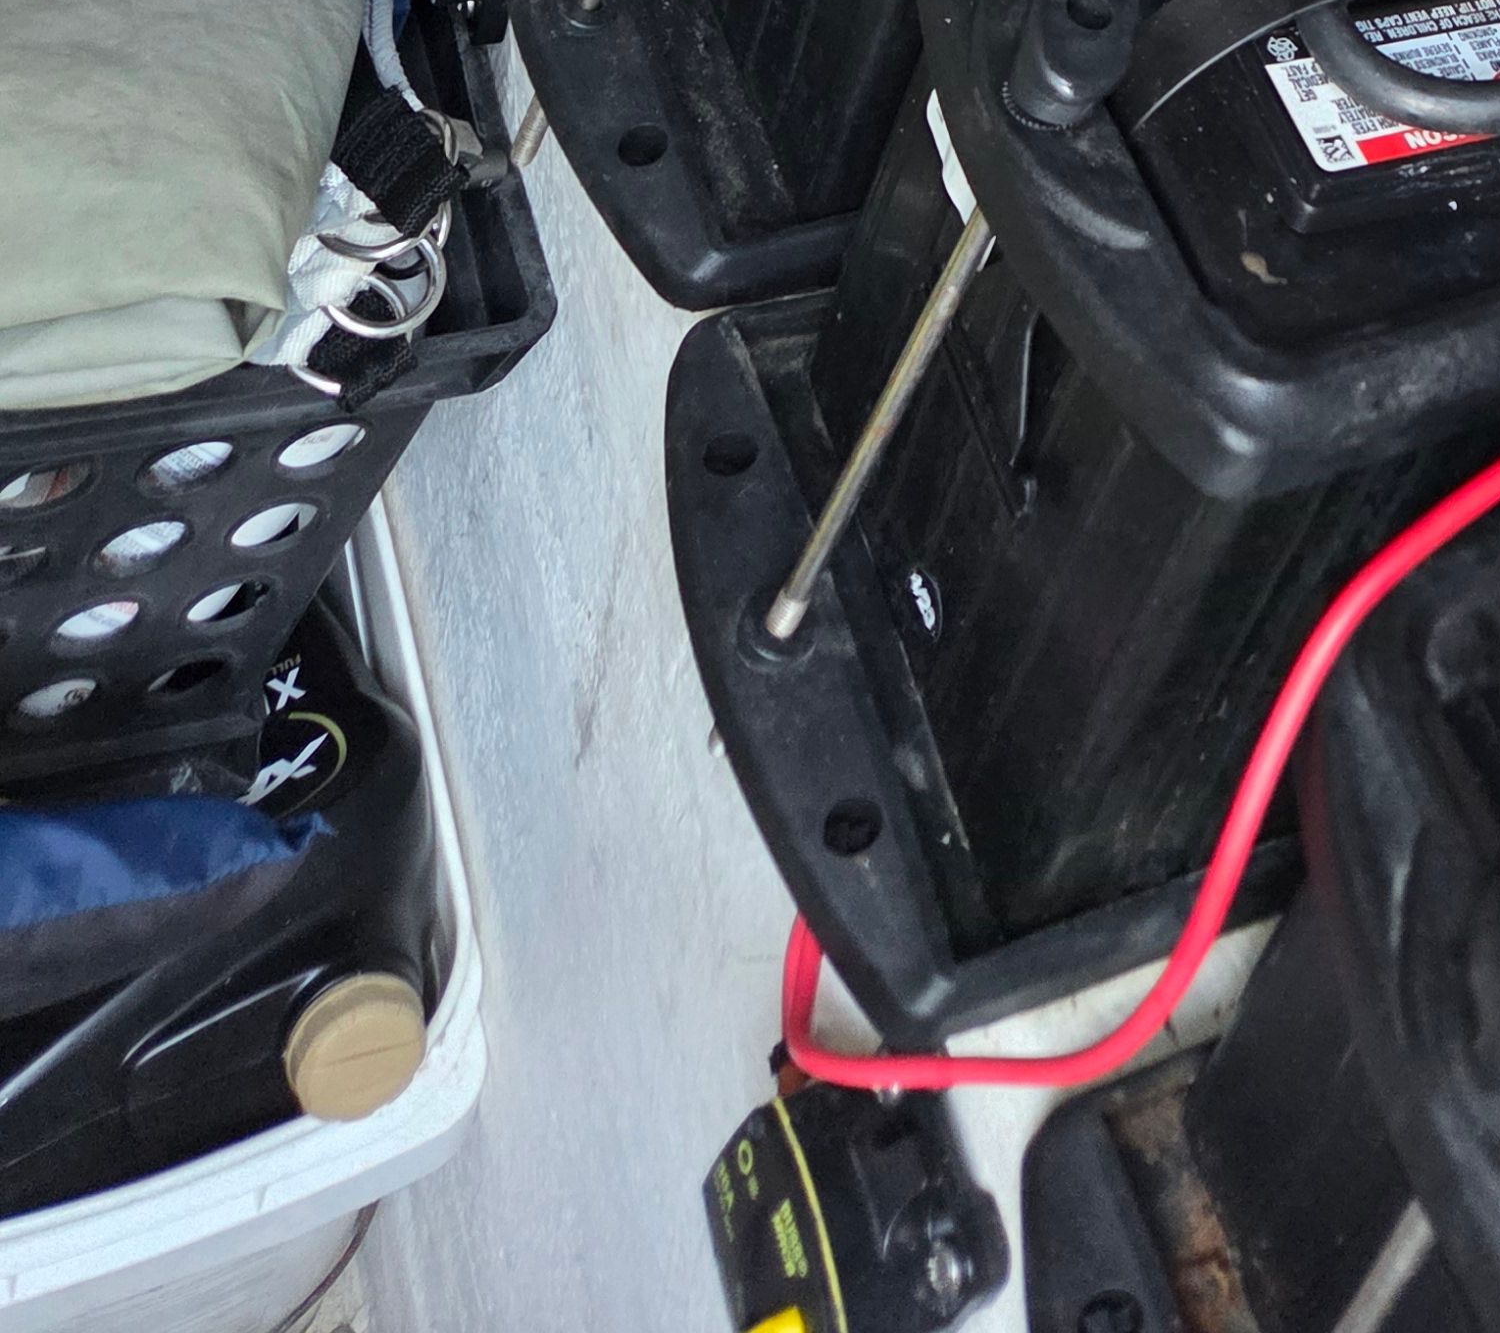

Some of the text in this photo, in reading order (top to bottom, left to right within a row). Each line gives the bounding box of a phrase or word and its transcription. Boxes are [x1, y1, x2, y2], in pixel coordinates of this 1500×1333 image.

[1401, 8, 1430, 24] VENT
[1428, 3, 1456, 19] KEEP
[1450, 10, 1486, 28] REACH
[1372, 12, 1403, 29] CAPS
